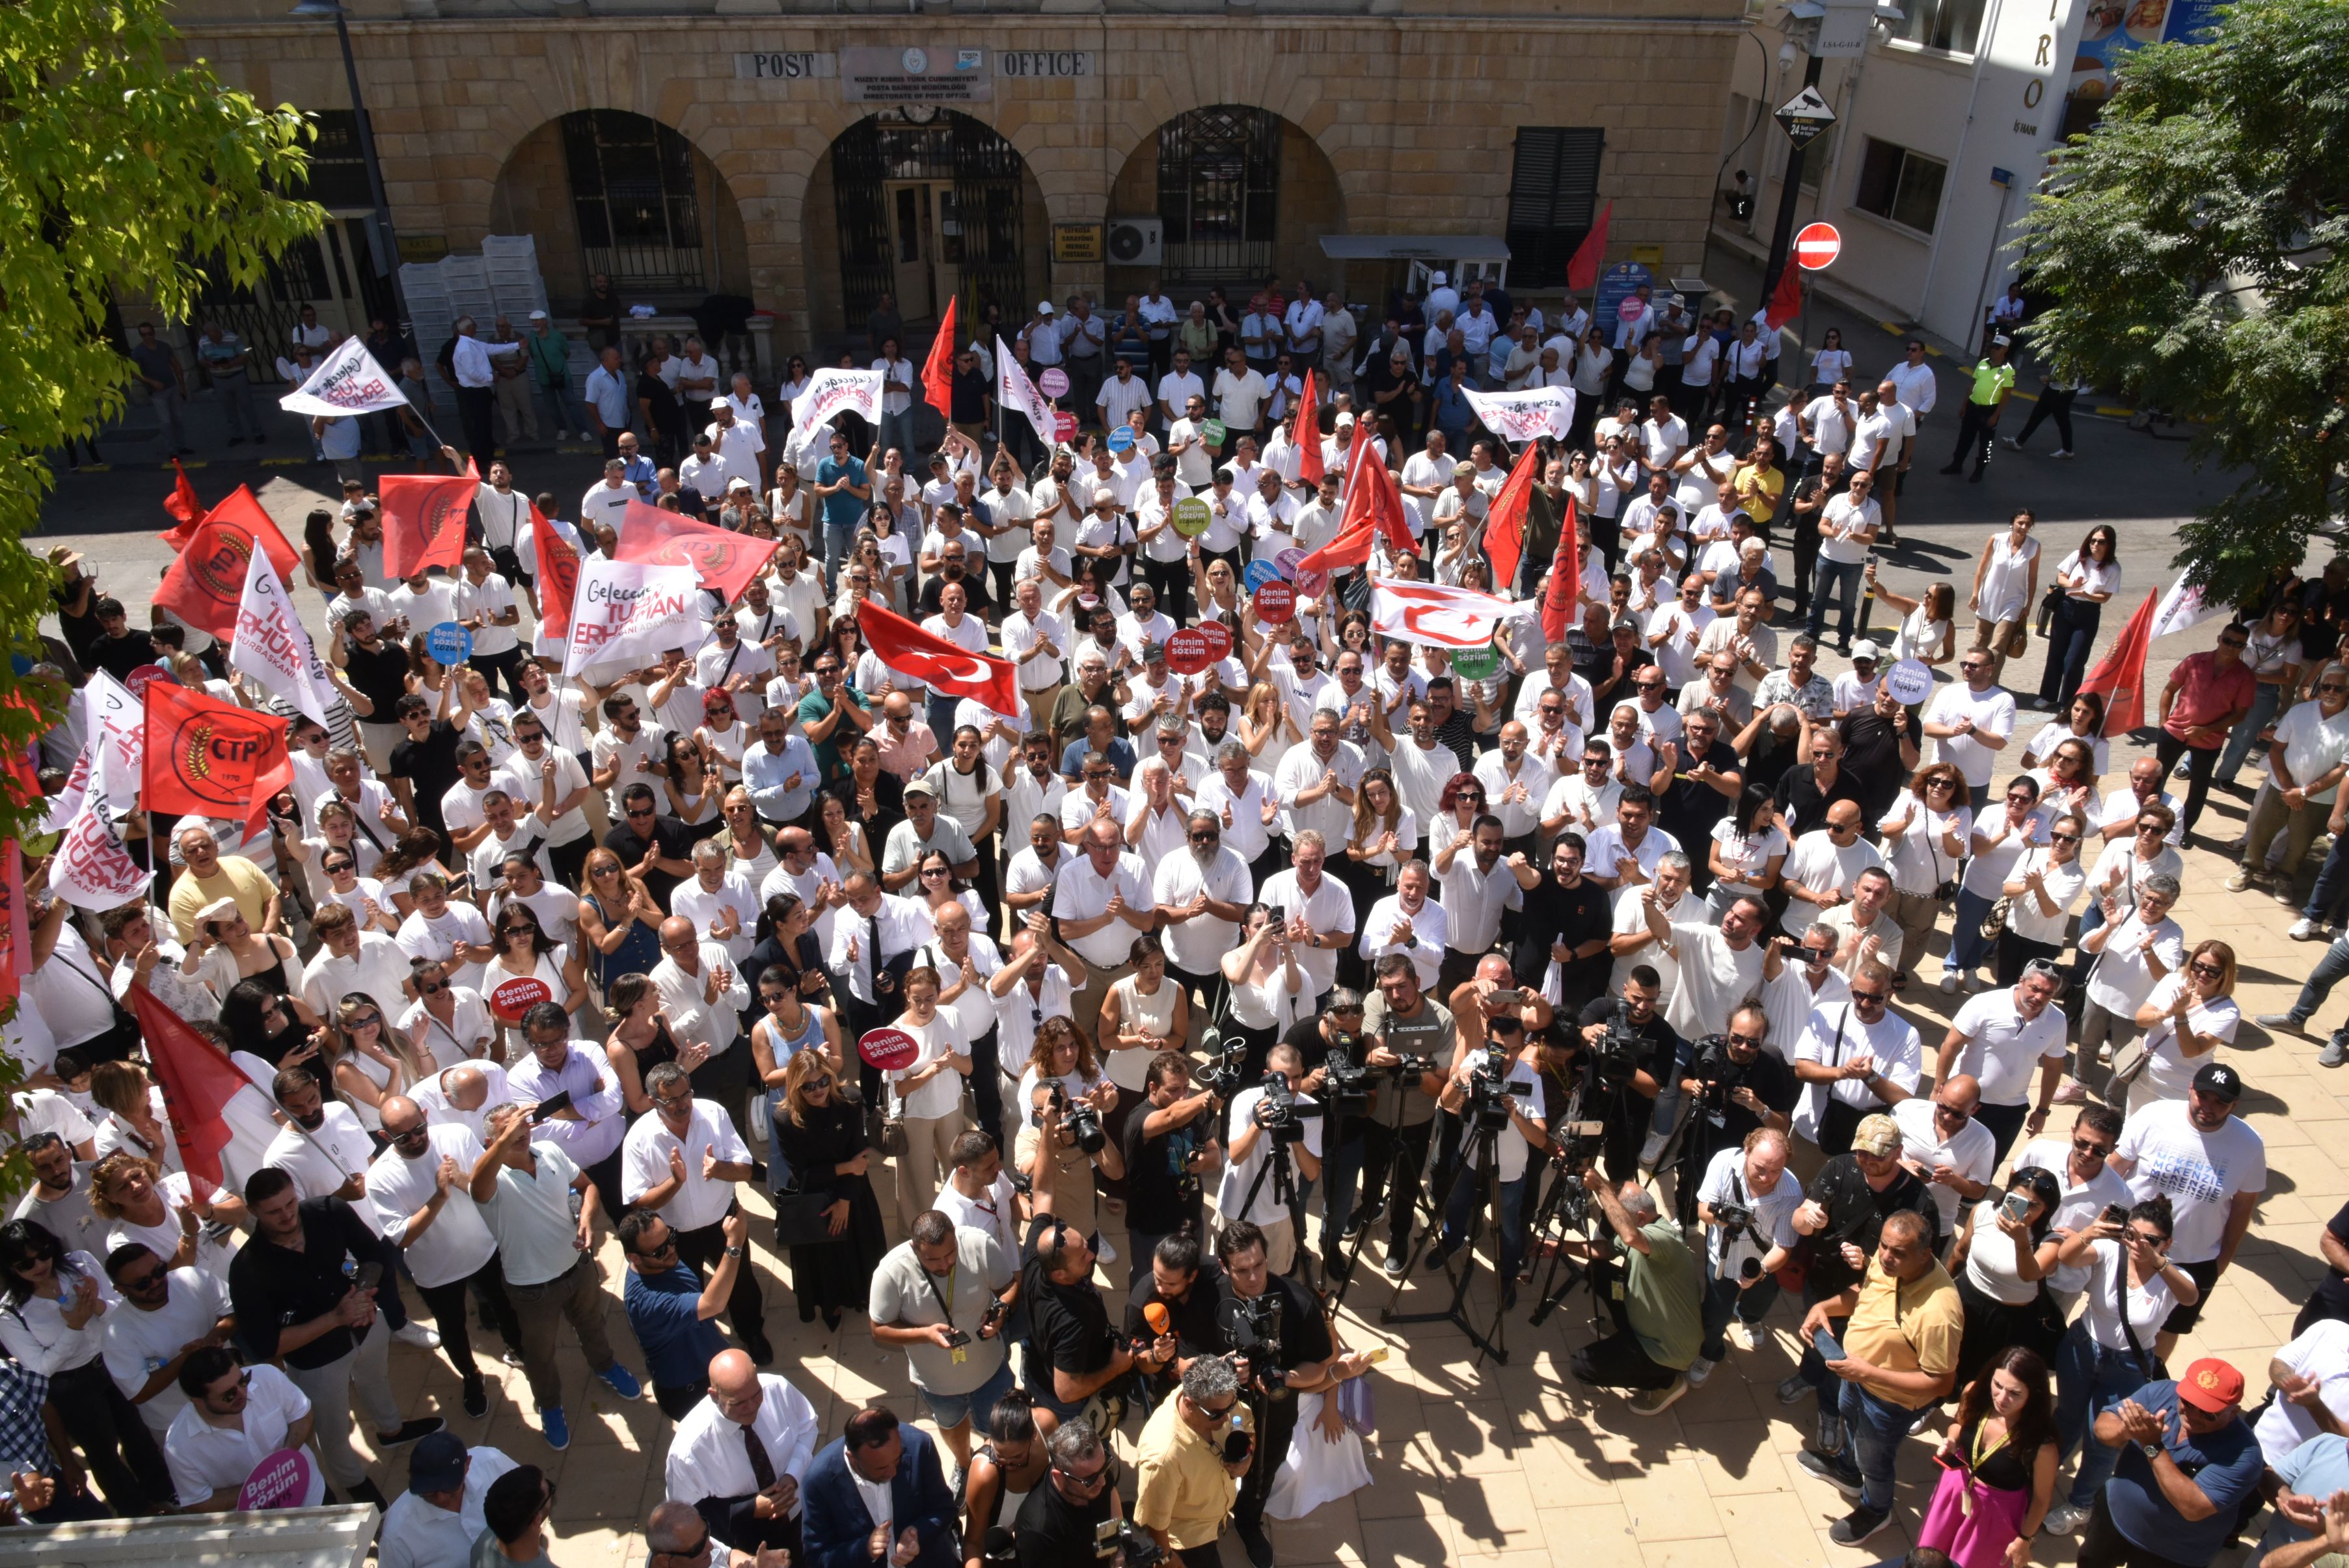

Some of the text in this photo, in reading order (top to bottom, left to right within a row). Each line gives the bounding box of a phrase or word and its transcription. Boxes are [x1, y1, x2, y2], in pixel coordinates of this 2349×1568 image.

[754, 53, 814, 77] POST
[1004, 52, 1085, 76] OFFICE
[1790, 124, 1800, 135] 24
[1533, 399, 1562, 409] imza
[1204, 427, 1223, 439] sözüm
[1206, 422, 1224, 433] Benim
[1178, 511, 1206, 519] sözüm
[1253, 561, 1278, 580] Benim
[1260, 596, 1290, 604] sözüm
[434, 627, 467, 639] Benim
[1208, 636, 1227, 645] züm
[433, 637, 467, 647] sözüm
[1172, 636, 1204, 646] Benim
[236, 633, 295, 679] HURBAŞKANI
[1172, 645, 1205, 655] sözüm
[1458, 652, 1490, 661] sözüm
[1895, 664, 1927, 679] Benim
[1892, 673, 1925, 688] sözüm
[1894, 679, 1921, 694] liyakat
[211, 738, 258, 763] CTP
[221, 773, 241, 781] 1970
[60, 845, 97, 895] BAŞKANI
[496, 982, 539, 999] Benim
[500, 990, 543, 1007] sözüm
[863, 1034, 903, 1050] Benim
[869, 1042, 910, 1058] sözüm
[246, 1457, 295, 1499] Benim
[249, 1470, 299, 1510] sözüm
